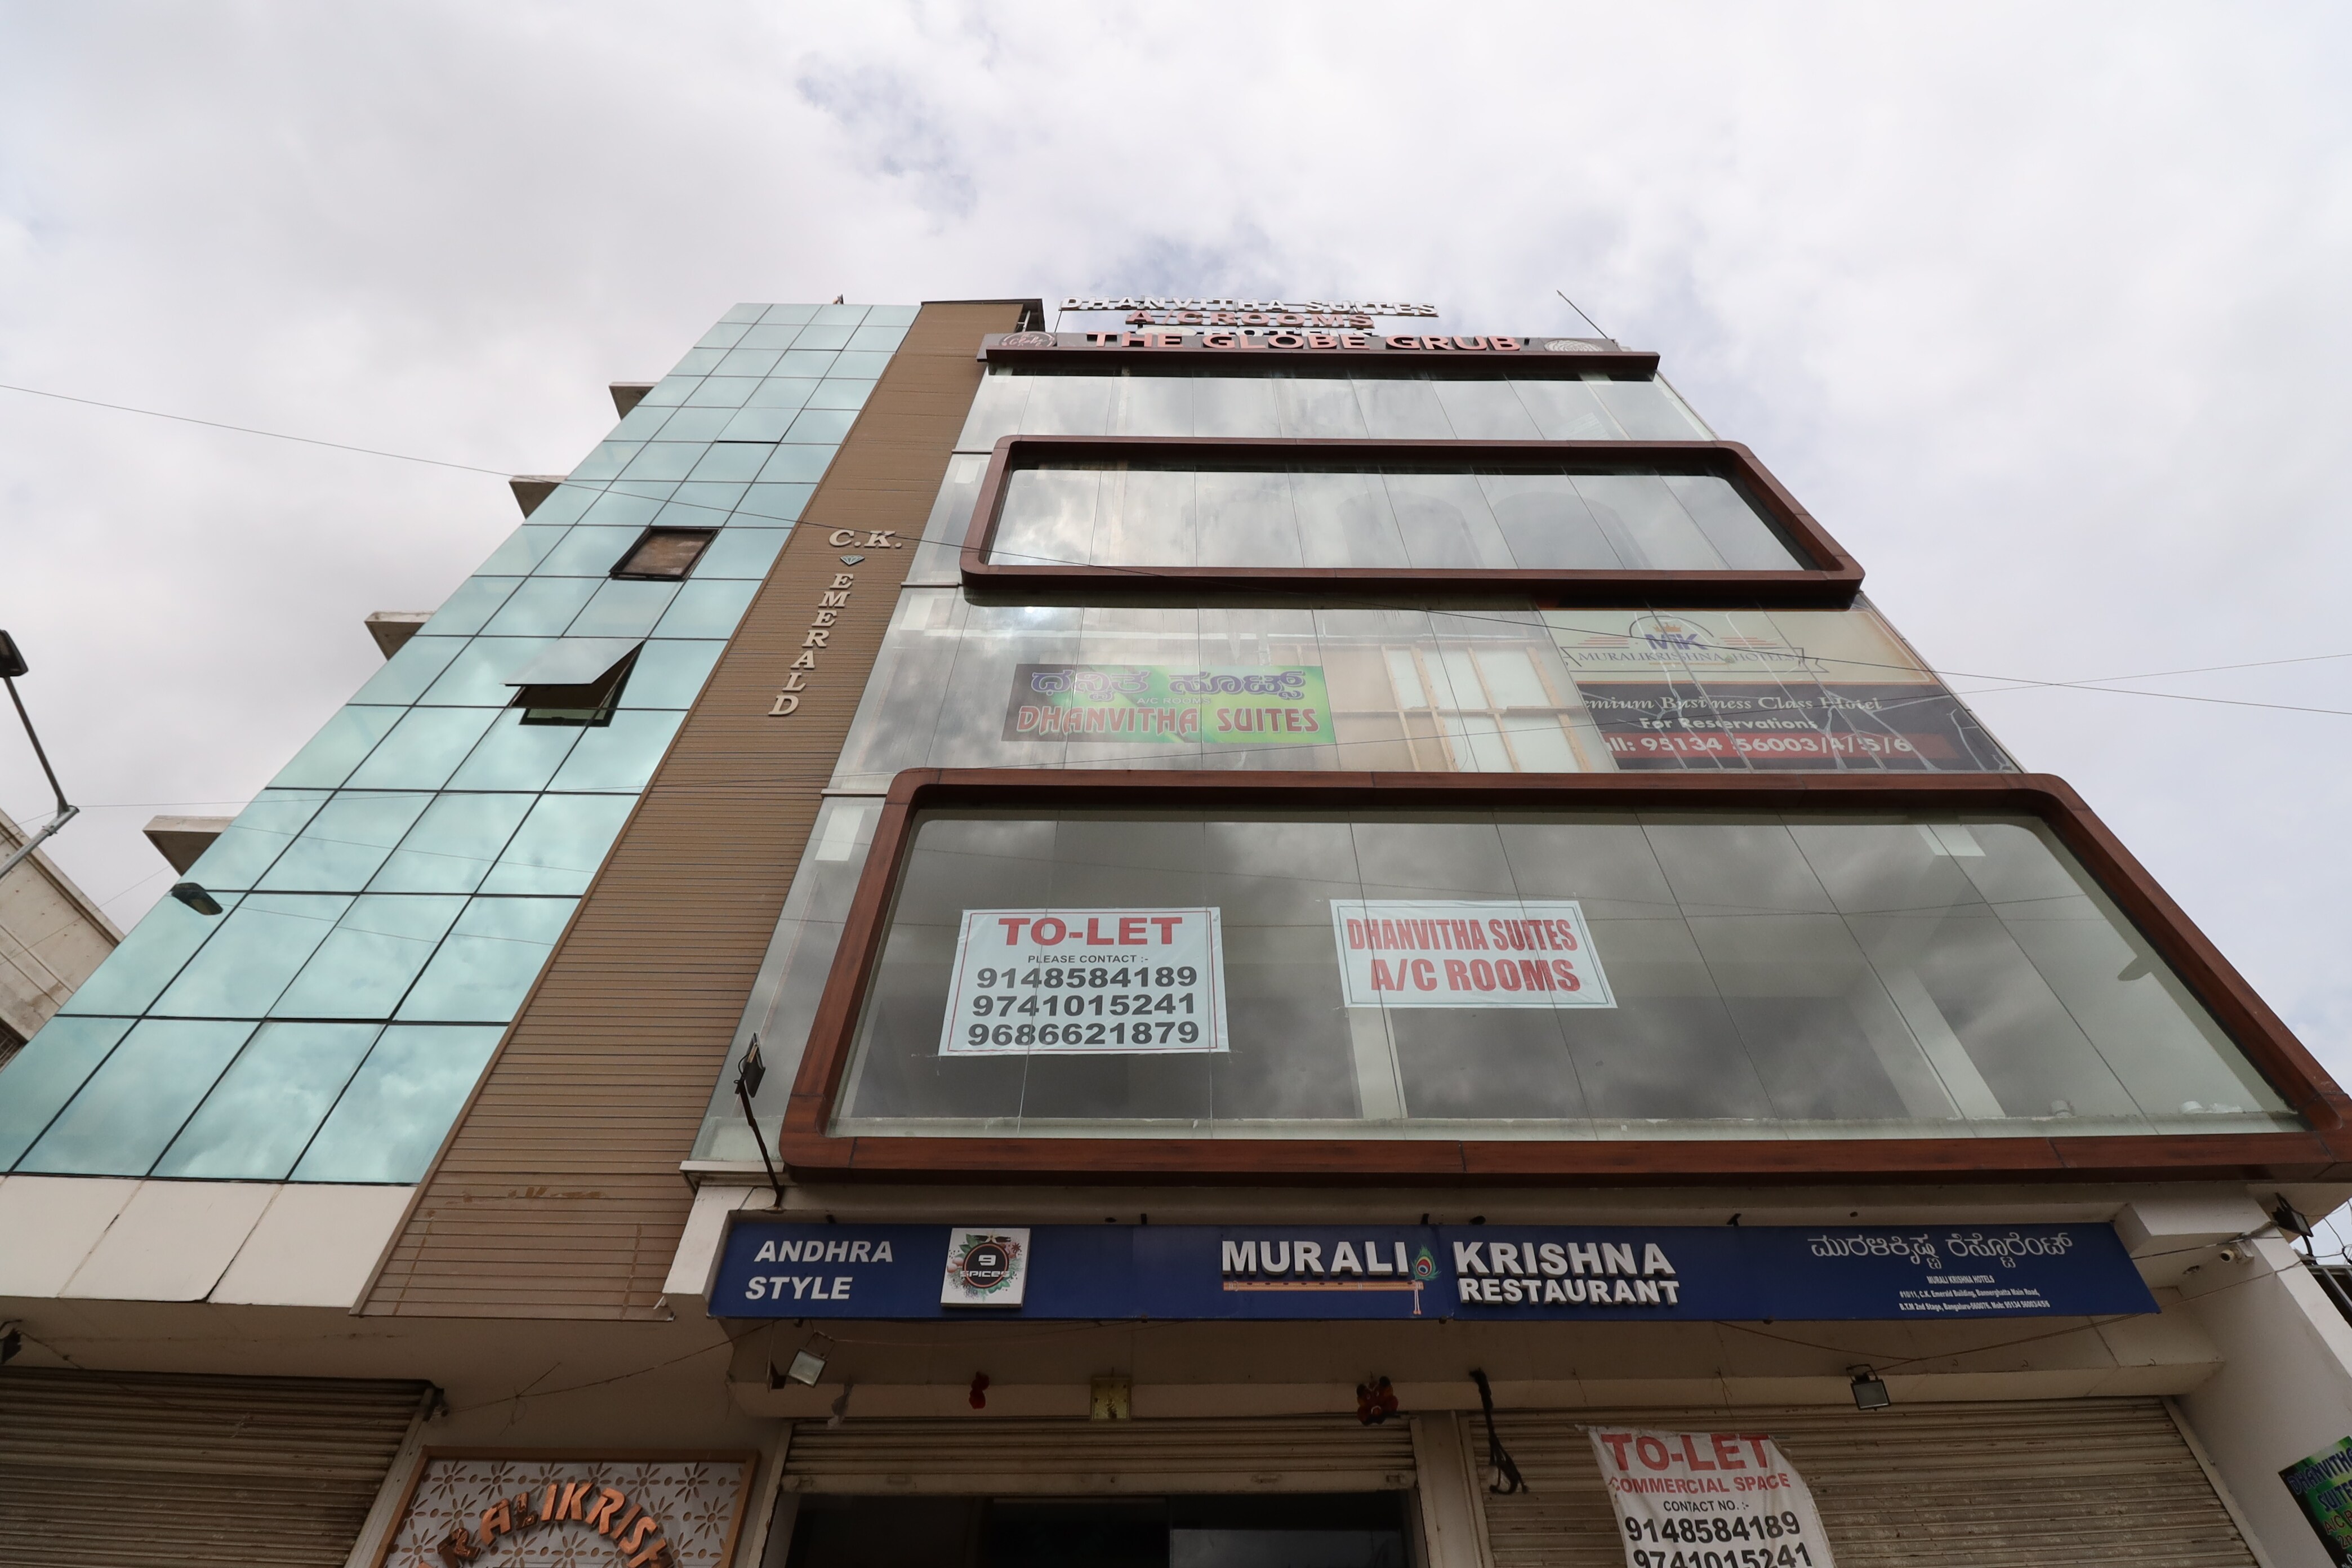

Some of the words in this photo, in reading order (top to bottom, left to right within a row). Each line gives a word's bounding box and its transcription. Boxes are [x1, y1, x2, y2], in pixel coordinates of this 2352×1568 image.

[1059, 296, 1288, 312] DHANVITHA
[1304, 300, 1438, 317] SUITES
[1125, 310, 1203, 325] A/C
[1209, 311, 1375, 328] ROOMS
[1086, 331, 1184, 348] THE
[1202, 333, 1370, 350] GLOBE
[1385, 334, 1521, 351] GRUB
[828, 529, 902, 549] C.K.
[768, 573, 854, 716] EMERALD
[1584, 696, 1655, 710] emium
[1758, 696, 1814, 710] Class
[1016, 705, 1200, 736] DHANVITHA
[1216, 707, 1320, 733] SUITES
[1638, 717, 1673, 729] For
[1640, 737, 1723, 751] 95134
[997, 916, 1183, 946] TO-LET
[1346, 918, 1490, 951] DHANVITHA
[1487, 919, 1579, 951] SUITES
[1027, 955, 1076, 964] PLEASE
[1079, 955, 1138, 964] CONTACT
[976, 966, 1198, 989] 9148584189
[1370, 958, 1438, 992] A/C
[1443, 959, 1582, 992] ROOMS
[972, 992, 1195, 1017] 9741015241
[967, 1021, 1200, 1046] 9686621879
[753, 1240, 893, 1263] ANDHRA
[978, 1254, 996, 1266] 9
[1221, 1240, 1410, 1277] MURALI
[1451, 1240, 1677, 1278] KRISHNA
[745, 1276, 853, 1300] STYLE
[1926, 1275, 1949, 1284] MURALI
[1948, 1275, 1974, 1284] KRISHNA
[1972, 1275, 1995, 1284] HOTELS
[1458, 1277, 1680, 1306] RESTAURANT
[1600, 1433, 1772, 1471] TO-LET
[1733, 1473, 1791, 1492] SPACE
[1663, 1500, 1714, 1513] CONTACT
[1718, 1500, 1740, 1512] NO.
[2317, 1479, 2352, 1513] SUITE
[1624, 1511, 1801, 1544] 9148584189
[1633, 1542, 1814, 1568] 9741015241
